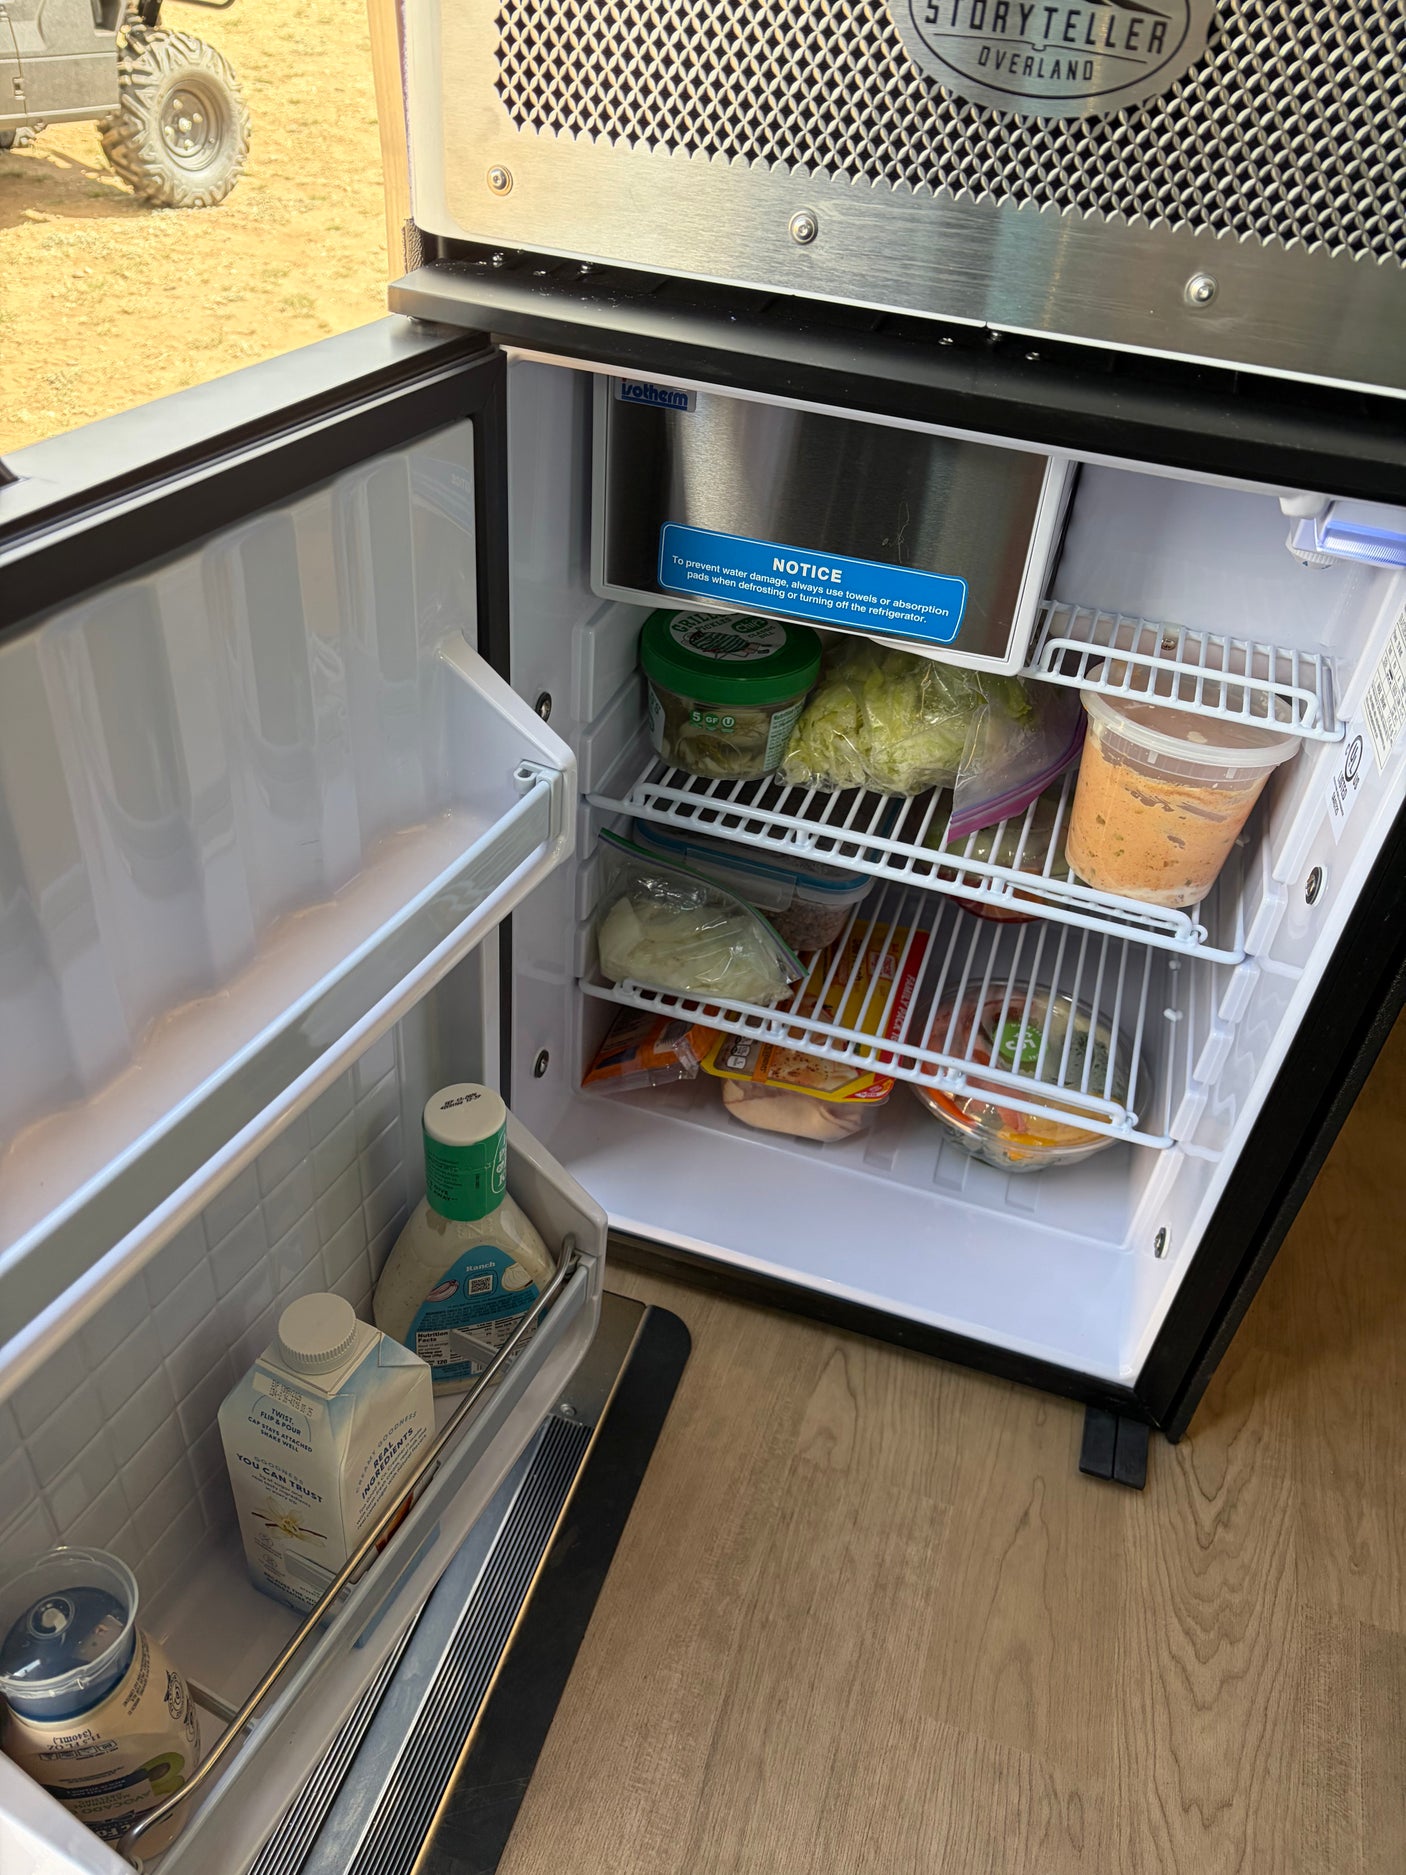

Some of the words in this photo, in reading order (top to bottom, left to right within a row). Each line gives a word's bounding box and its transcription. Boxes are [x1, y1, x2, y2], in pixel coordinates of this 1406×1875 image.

[925, 0, 1168, 54] STORYTELLER
[978, 46, 1094, 81] OVERLAND
[621, 378, 689, 407] isotherm
[672, 554, 684, 566] To
[685, 559, 721, 573] prevent
[722, 567, 748, 579] water
[749, 572, 789, 588] damage,
[791, 581, 824, 594] always
[826, 587, 844, 598] use
[845, 591, 878, 604] towels
[879, 598, 892, 606] or
[892, 599, 950, 617] absorption
[772, 557, 843, 584] NOTICE
[687, 570, 710, 582] pads
[711, 577, 736, 588] when
[738, 581, 785, 599] defrosting
[787, 591, 798, 600] or
[799, 593, 834, 609] turning
[835, 600, 850, 610] off
[851, 602, 867, 613] the
[868, 607, 927, 624] refrigerator.
[900, 973, 916, 1009] FAMILY
[892, 1005, 908, 1032] PACK
[466, 1260, 496, 1273] Ranch
[247, 1416, 261, 1426] CAP
[262, 1423, 280, 1436] STAYS
[281, 1433, 313, 1453] ATTACHED
[260, 1411, 275, 1421] FLIP
[281, 1423, 301, 1436] POUR
[260, 1429, 281, 1443] SHAKE
[282, 1440, 299, 1453] WELL
[355, 1448, 376, 1494] CREAMY
[377, 1410, 417, 1448] GOODNESS
[373, 1441, 394, 1469] REAL
[236, 1453, 260, 1469] YOU
[262, 1467, 287, 1484] CAN
[289, 1480, 323, 1503] TRUST
[254, 1456, 304, 1485] GOODNESS
[361, 1427, 414, 1500] INGREDIENTS
[81, 1789, 152, 1814] AVOCADO
